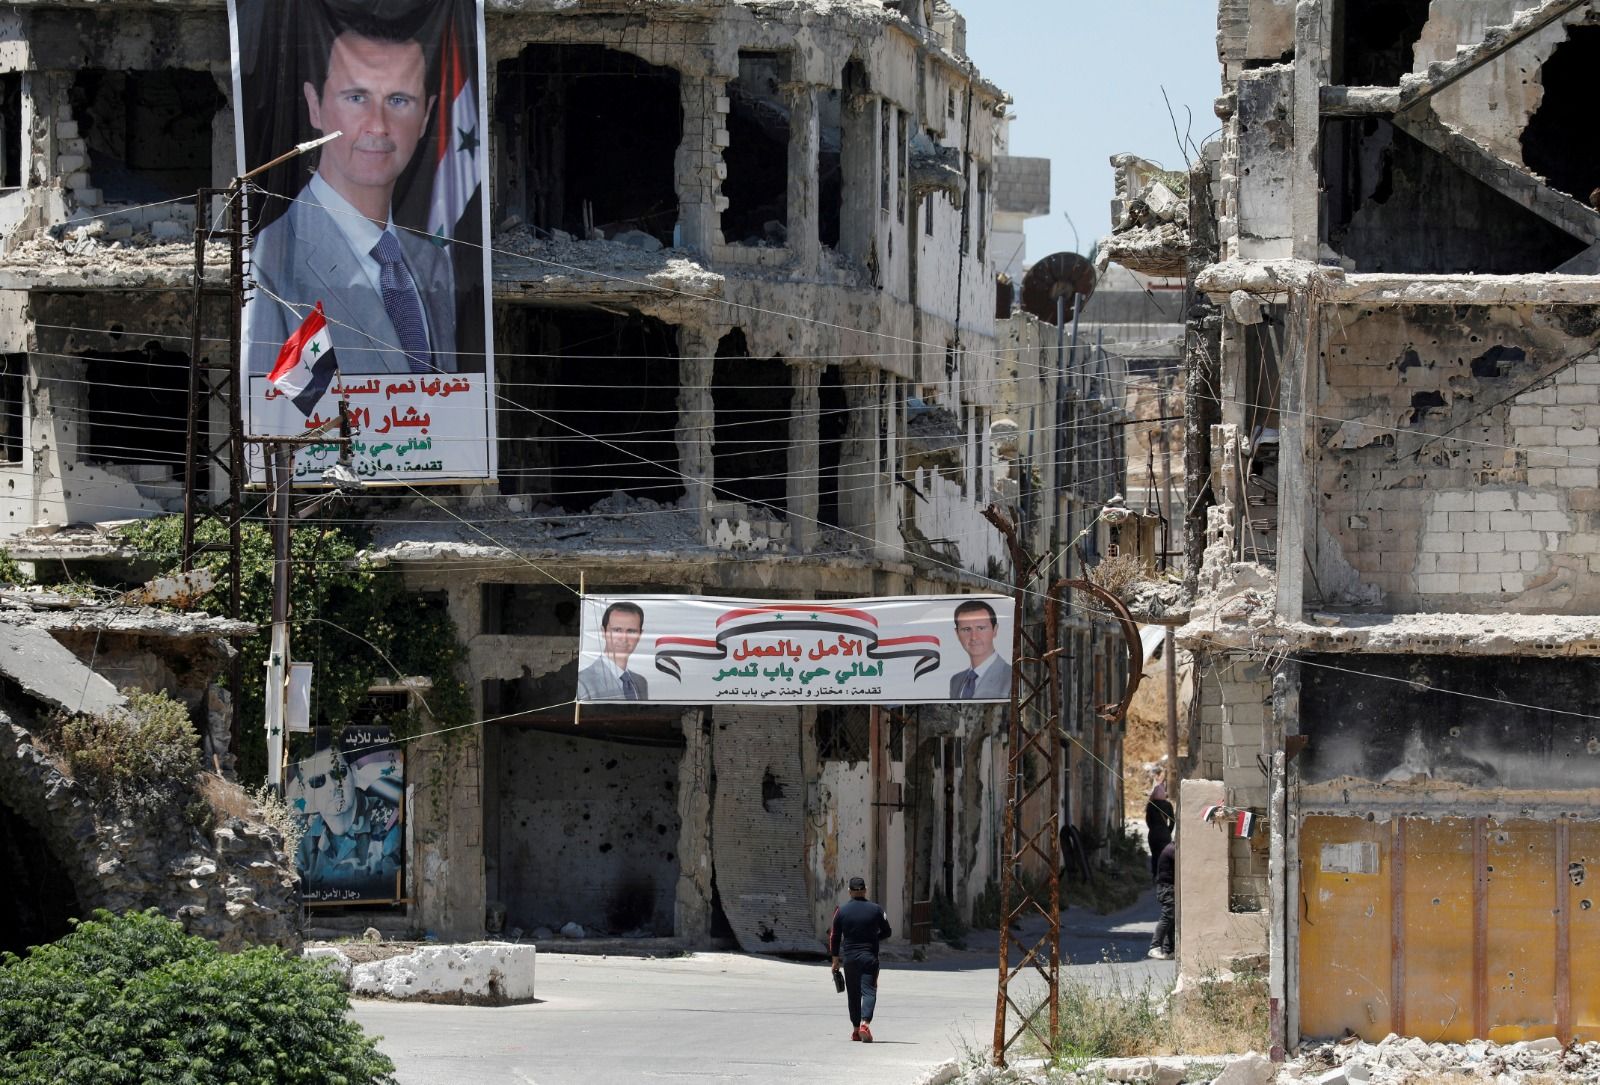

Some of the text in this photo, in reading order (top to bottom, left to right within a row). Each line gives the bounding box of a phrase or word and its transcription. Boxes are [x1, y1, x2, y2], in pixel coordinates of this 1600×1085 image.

[385, 379, 416, 400] نعم
[375, 406, 430, 434] بشار
[369, 442, 393, 457] حي
[396, 437, 432, 456] أهالي
[357, 459, 393, 477] مازن
[403, 460, 443, 471] تقدمة
[733, 634, 863, 662] الأمل بالعمل
[712, 660, 884, 685] أهالي حي باب تدمر
[715, 687, 739, 697] تدمر
[741, 687, 758, 697] باب
[760, 689, 777, 699] حي
[779, 687, 803, 696] لجنة
[814, 687, 843, 698] مختار
[852, 687, 882, 695] تقدمة
[345, 730, 372, 746] للأبد
[321, 888, 341, 900] الأمن
[342, 889, 361, 900] رجال
